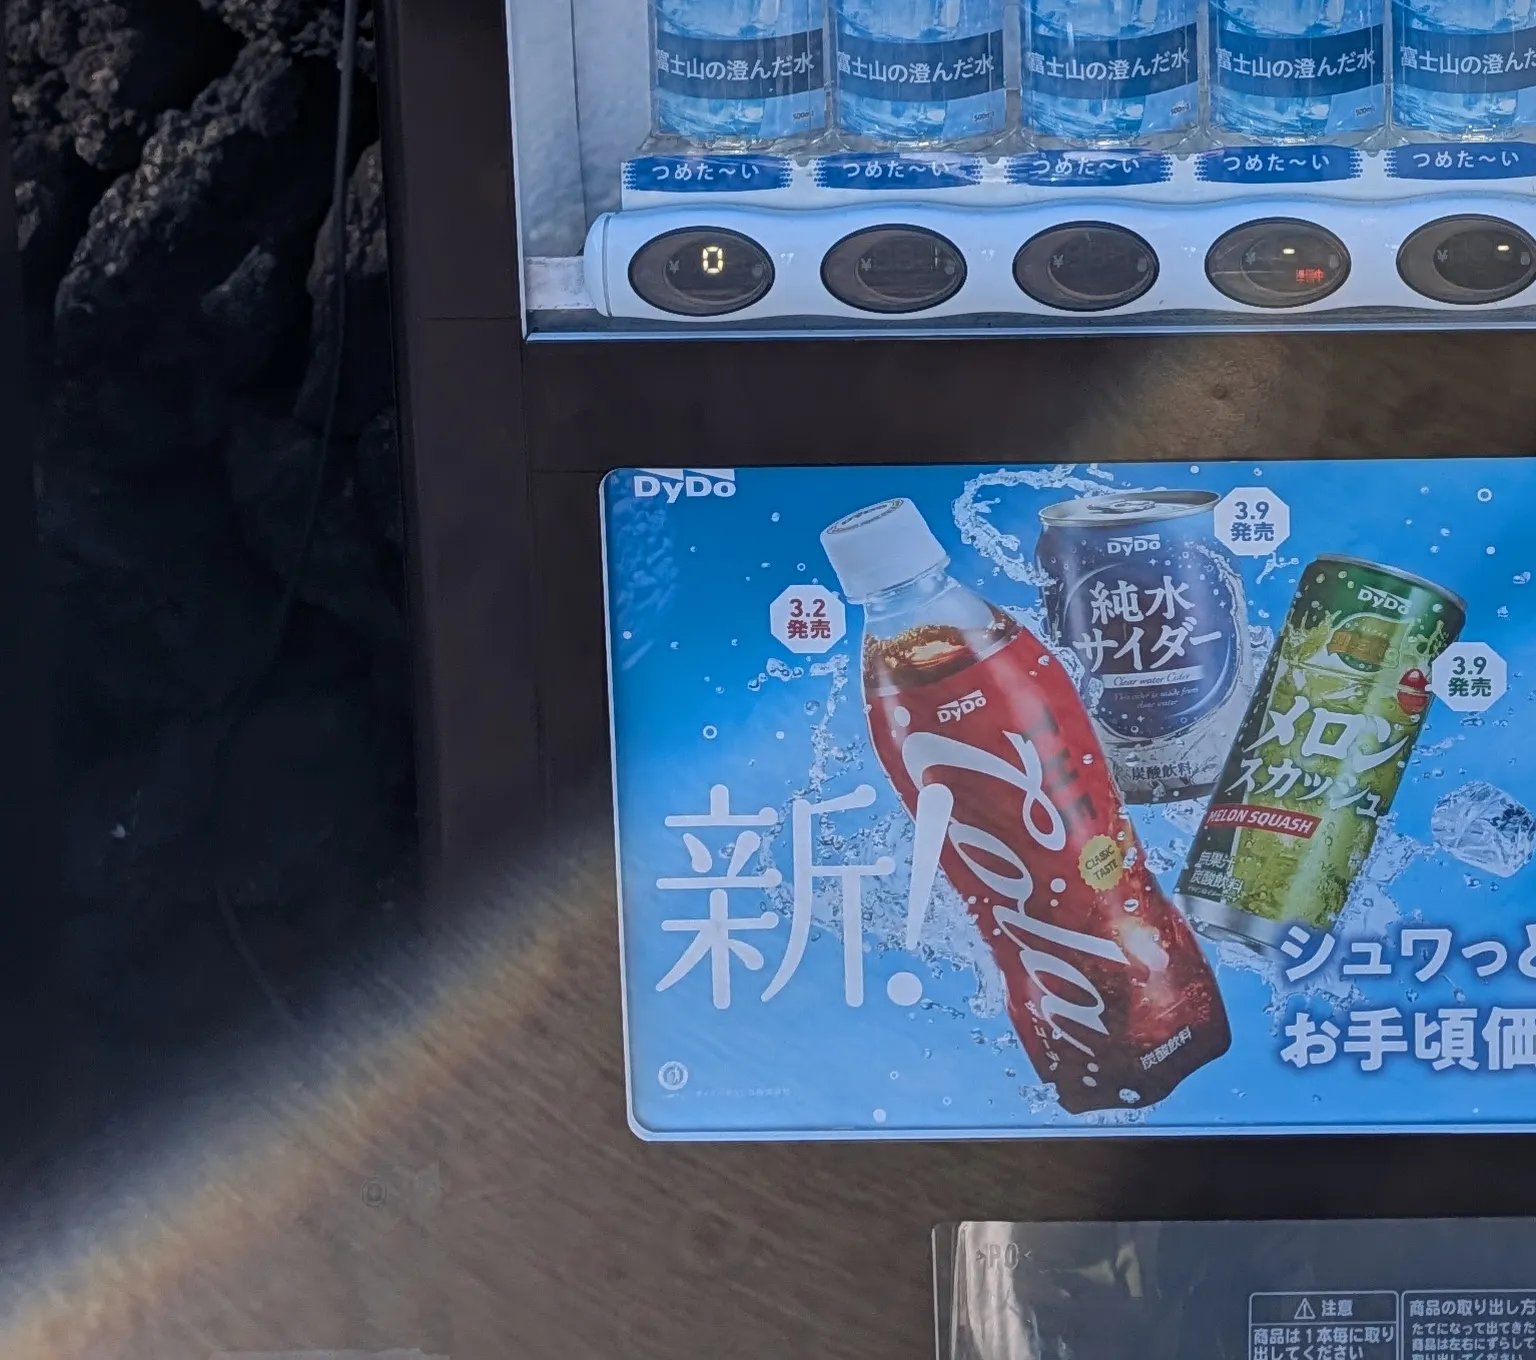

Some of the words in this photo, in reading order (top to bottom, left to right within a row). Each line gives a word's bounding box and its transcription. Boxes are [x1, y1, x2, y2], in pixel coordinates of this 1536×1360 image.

[633, 469, 737, 504] DyDo
[1234, 500, 1269, 521] 3.9
[1230, 521, 1274, 542] 発売
[1107, 535, 1161, 556] DyDo
[790, 598, 826, 618] 3.2
[1089, 578, 1192, 625] 純水
[1358, 586, 1413, 615] DyDo
[787, 619, 832, 640] 発売
[1074, 626, 1224, 671] サイダー
[1452, 656, 1487, 676] 3.9
[1448, 676, 1492, 698] 発売
[936, 690, 987, 724] DyDo
[1245, 695, 1411, 774] メロン
[1224, 756, 1381, 818] スカッシュ
[1208, 808, 1250, 824] MELON
[1247, 810, 1314, 834] SQUASH
[1092, 859, 1121, 881] TASTE
[1321, 1299, 1354, 1317] 注意
[1409, 1298, 1536, 1317] 商品の取り出し方
